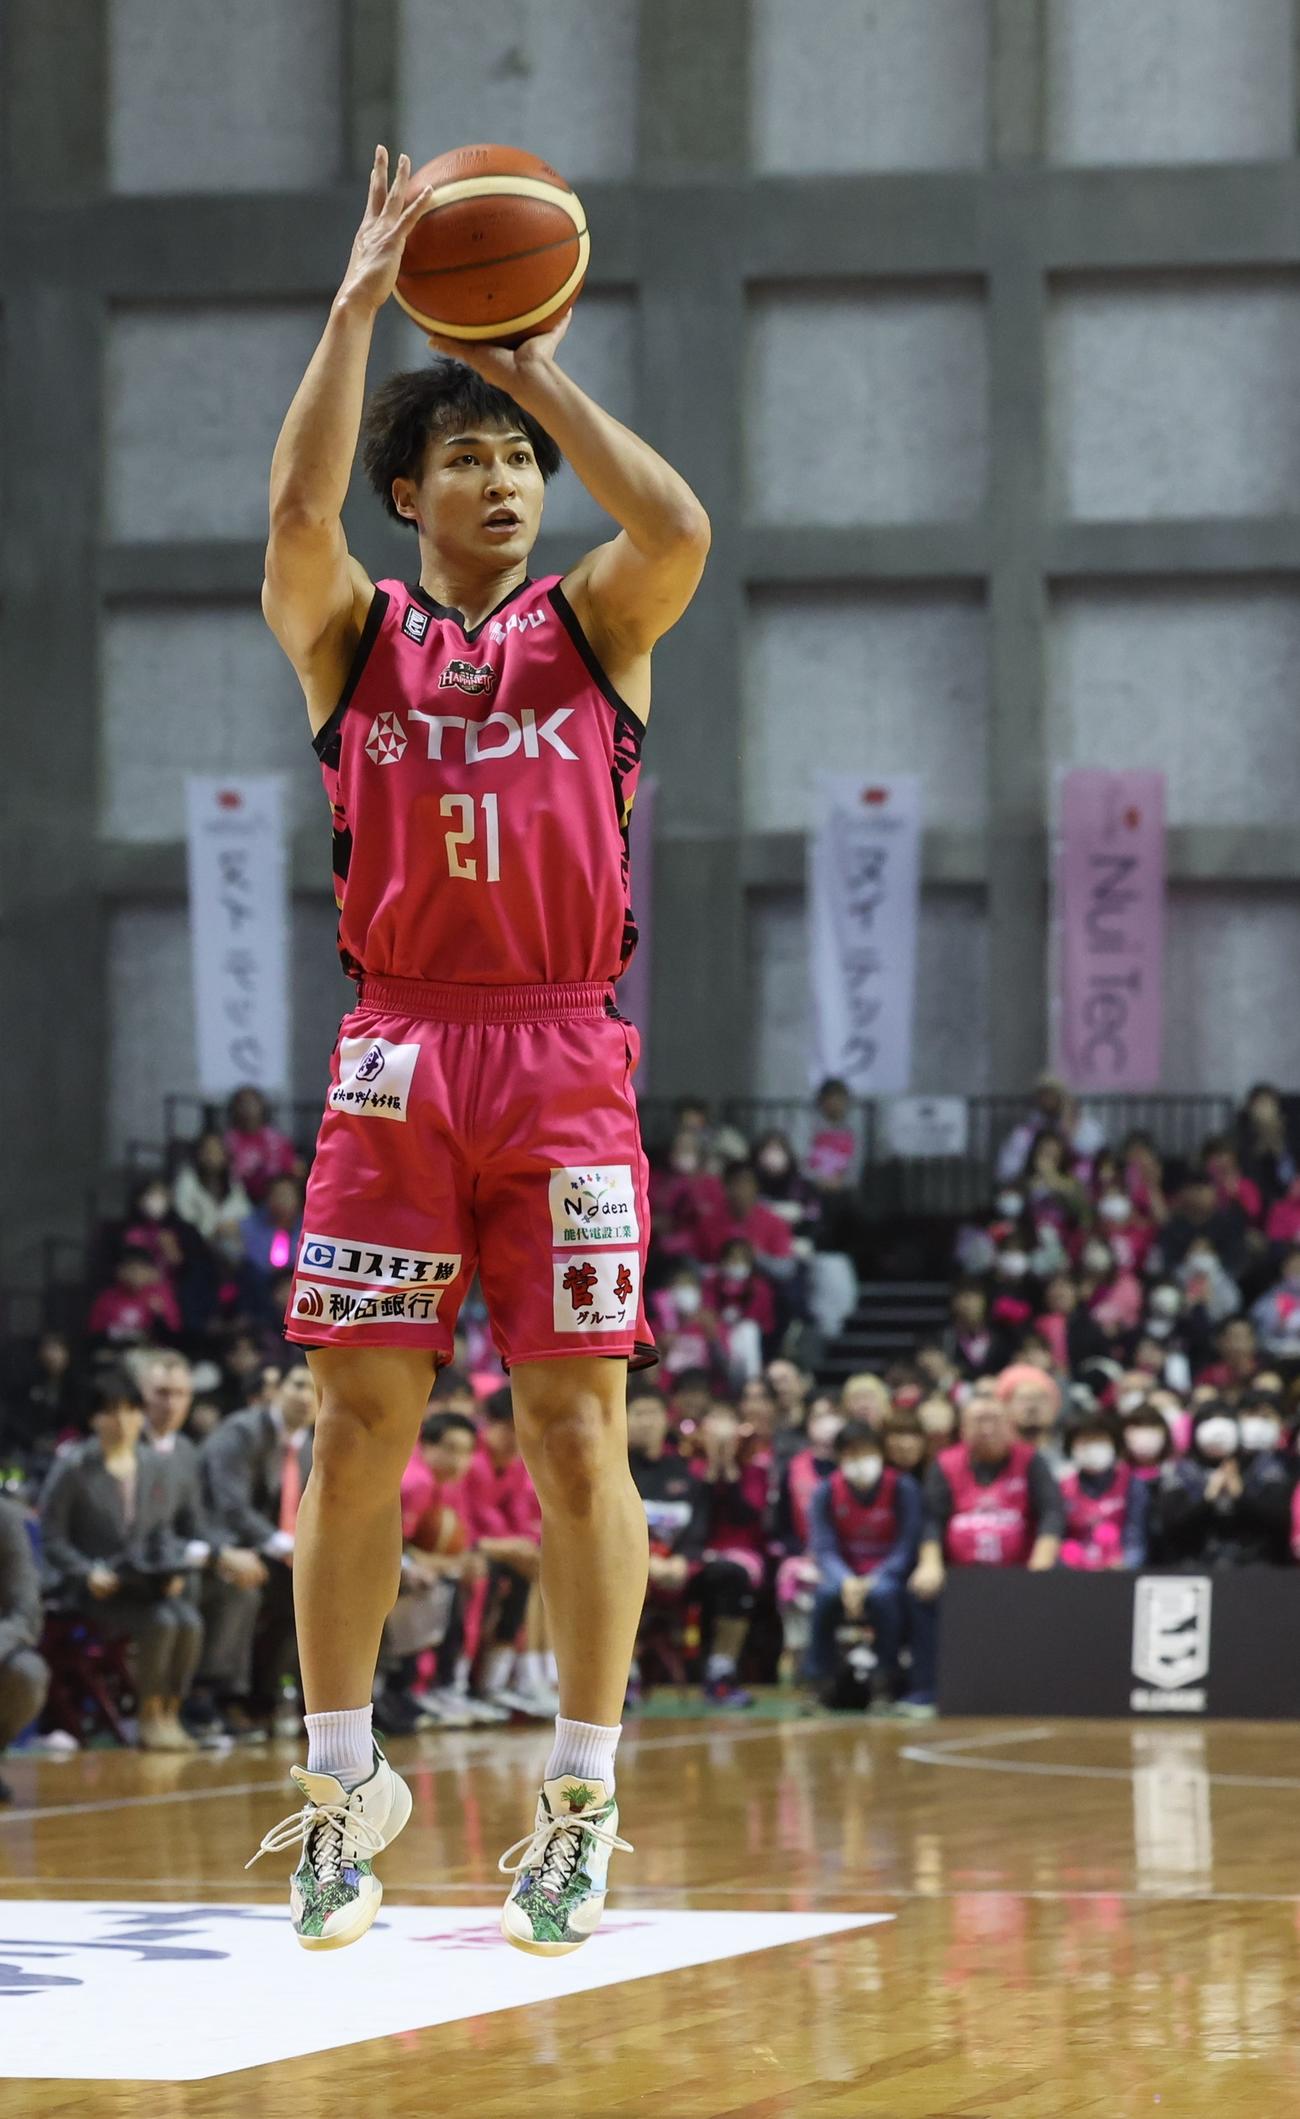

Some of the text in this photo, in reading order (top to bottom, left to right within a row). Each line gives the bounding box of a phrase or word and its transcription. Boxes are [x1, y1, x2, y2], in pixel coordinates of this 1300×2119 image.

[408, 708, 580, 765] TDK
[440, 793, 501, 882] 21
[338, 1248, 455, 1282] コスモ工機
[329, 1292, 436, 1321] 秋田銀行
